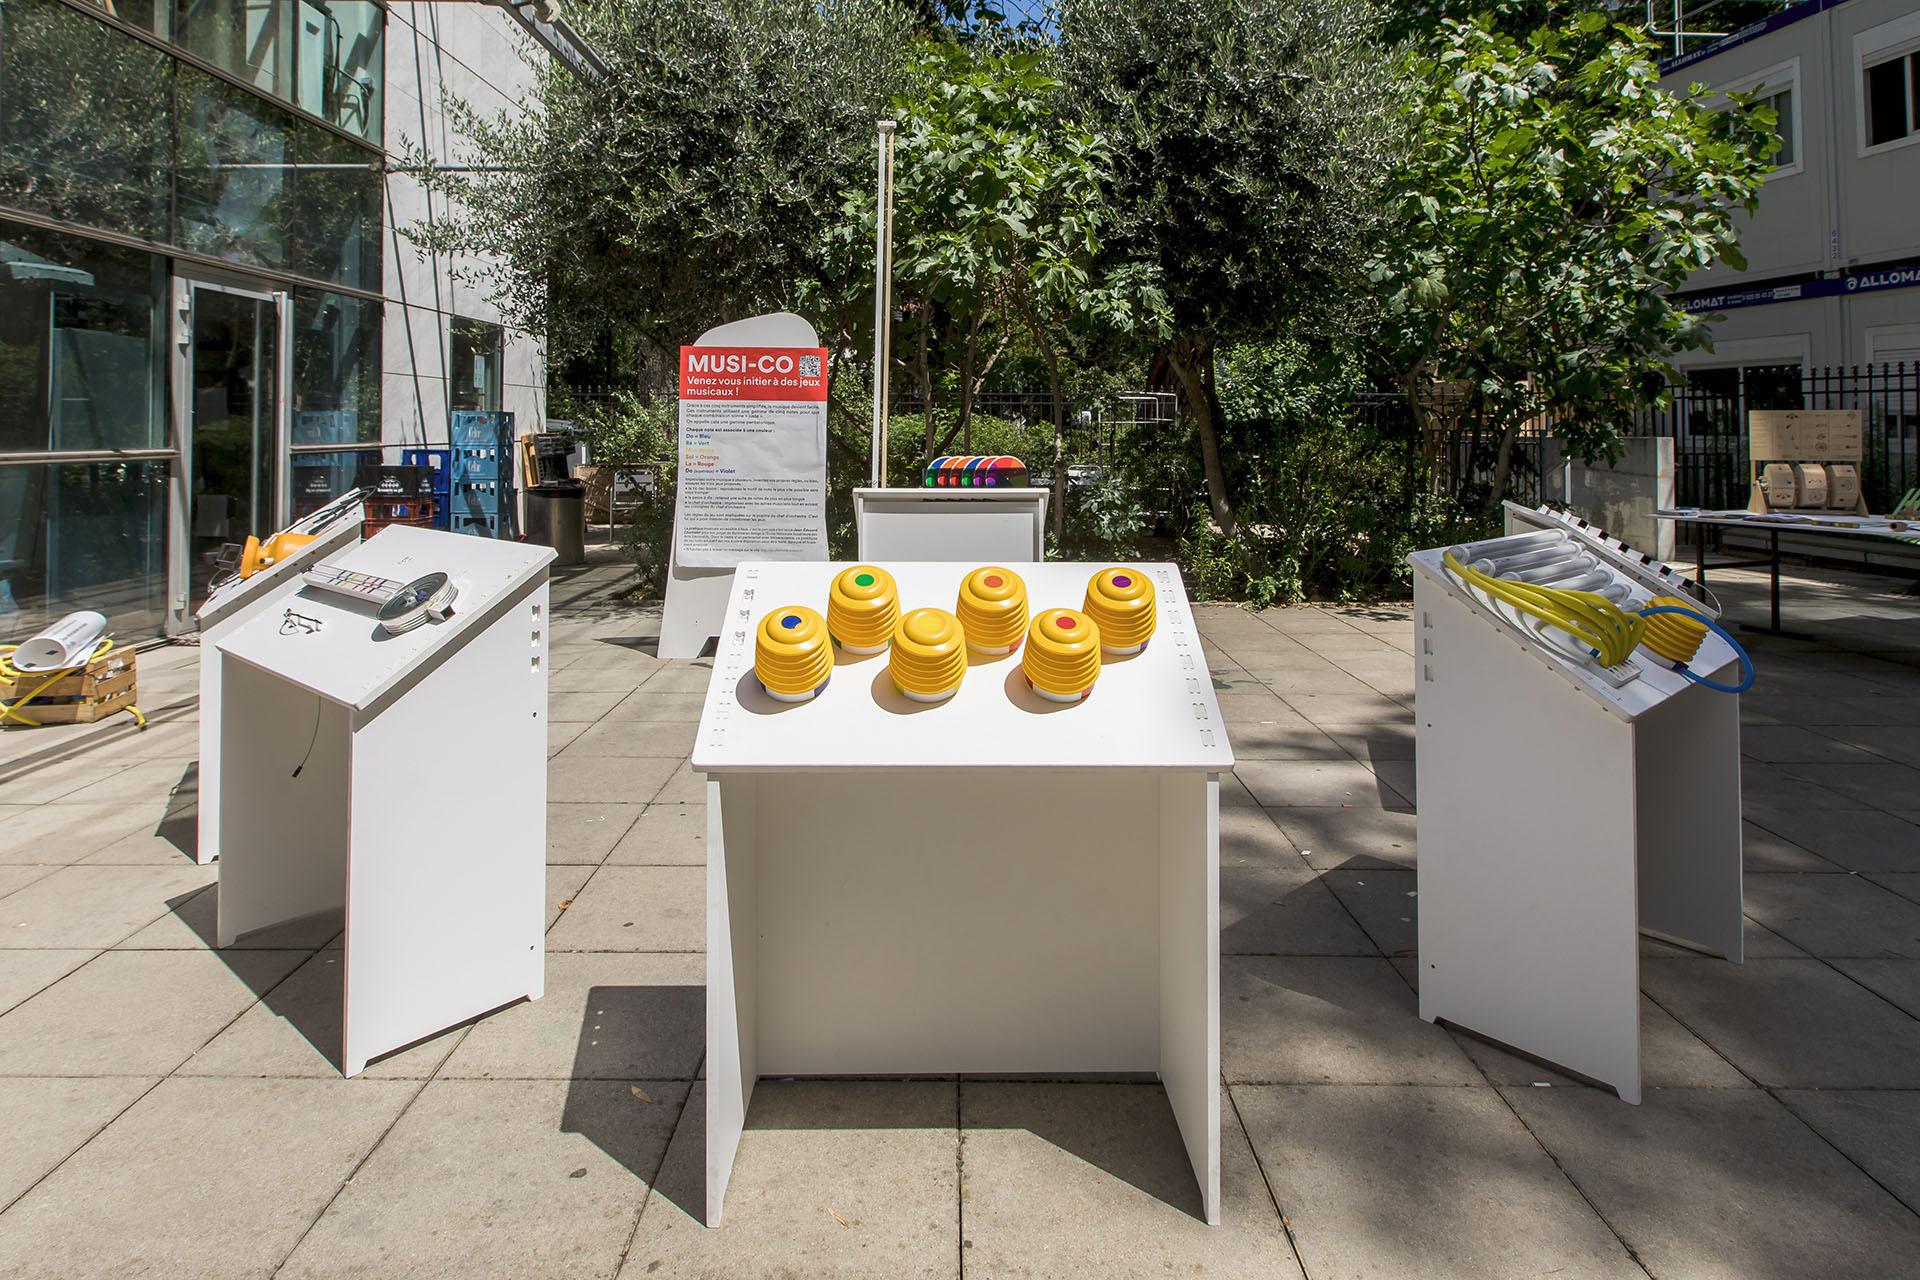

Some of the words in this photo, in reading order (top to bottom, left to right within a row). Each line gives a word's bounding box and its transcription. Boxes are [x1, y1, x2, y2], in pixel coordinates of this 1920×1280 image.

[1674, 296, 1725, 310] LOMAT
[688, 354, 794, 374] MUSI-CO
[687, 376, 716, 385] Venez
[744, 376, 770, 385] initier
[773, 376, 778, 386] à
[780, 377, 798, 386] des
[799, 378, 820, 388] jeux
[687, 387, 733, 396] musicaux
[736, 387, 739, 396] !
